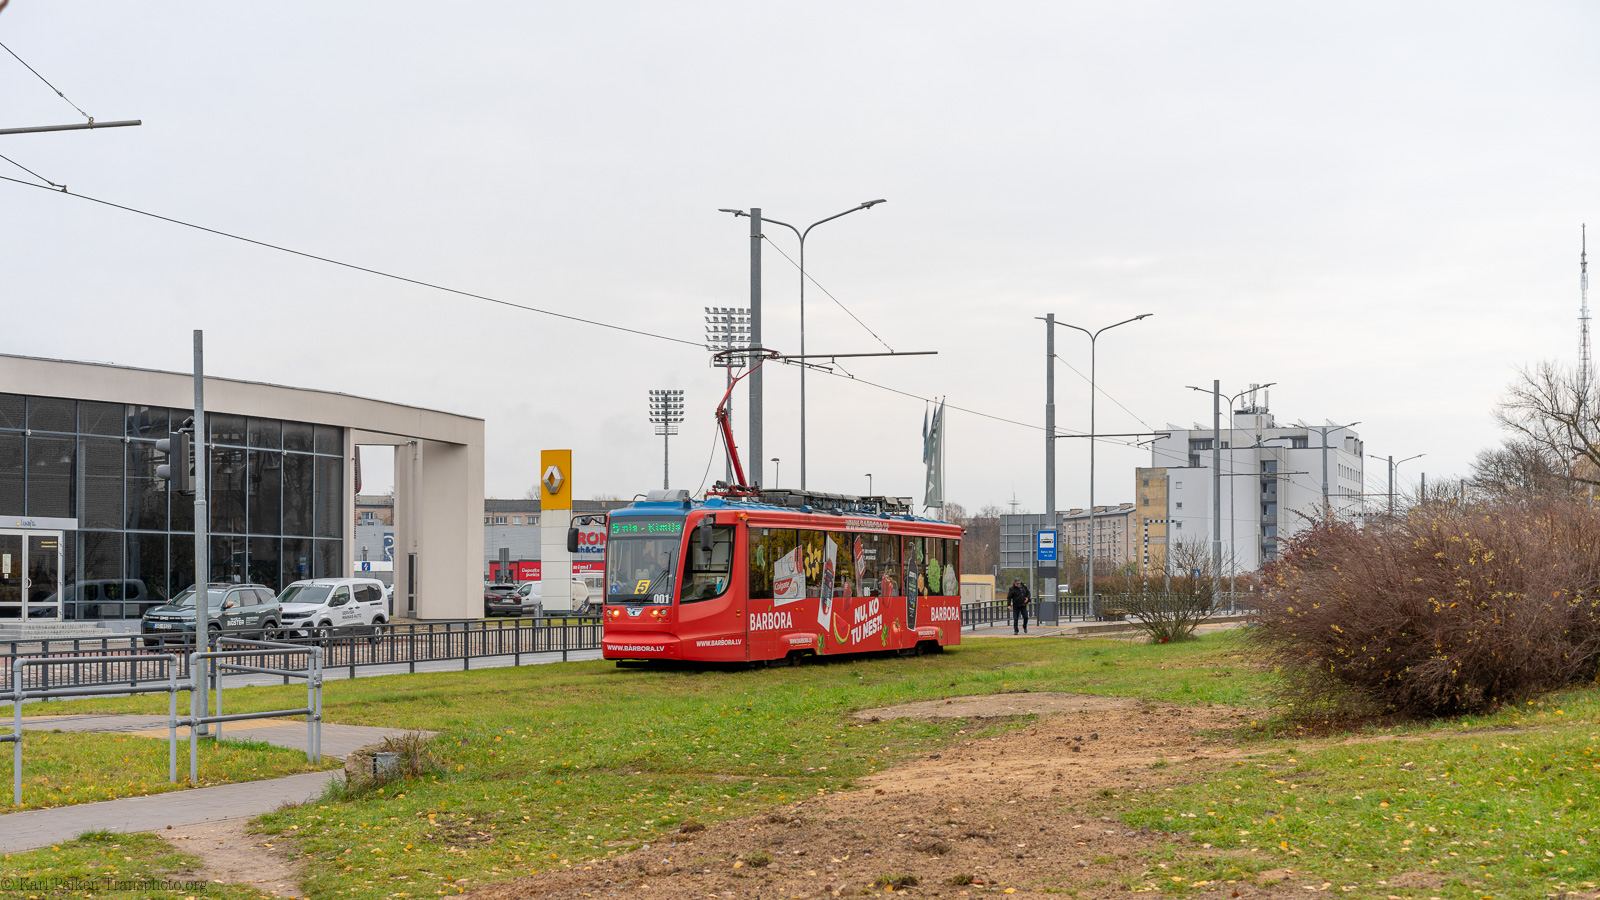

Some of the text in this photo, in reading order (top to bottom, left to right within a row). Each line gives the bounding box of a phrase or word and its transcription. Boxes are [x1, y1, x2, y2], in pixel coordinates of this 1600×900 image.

[612, 522, 620, 534] 5
[637, 581, 648, 593] 5
[775, 581, 790, 592] Colgate
[653, 593, 670, 604] 001
[854, 597, 880, 625] NU, KO
[930, 606, 960, 622] BARBORA
[749, 611, 793, 631] BARBORA
[850, 625, 862, 646] TU
[606, 644, 665, 652] WWW.BARBORA.LV
[696, 638, 742, 647] WWW.BARBORA.LV
